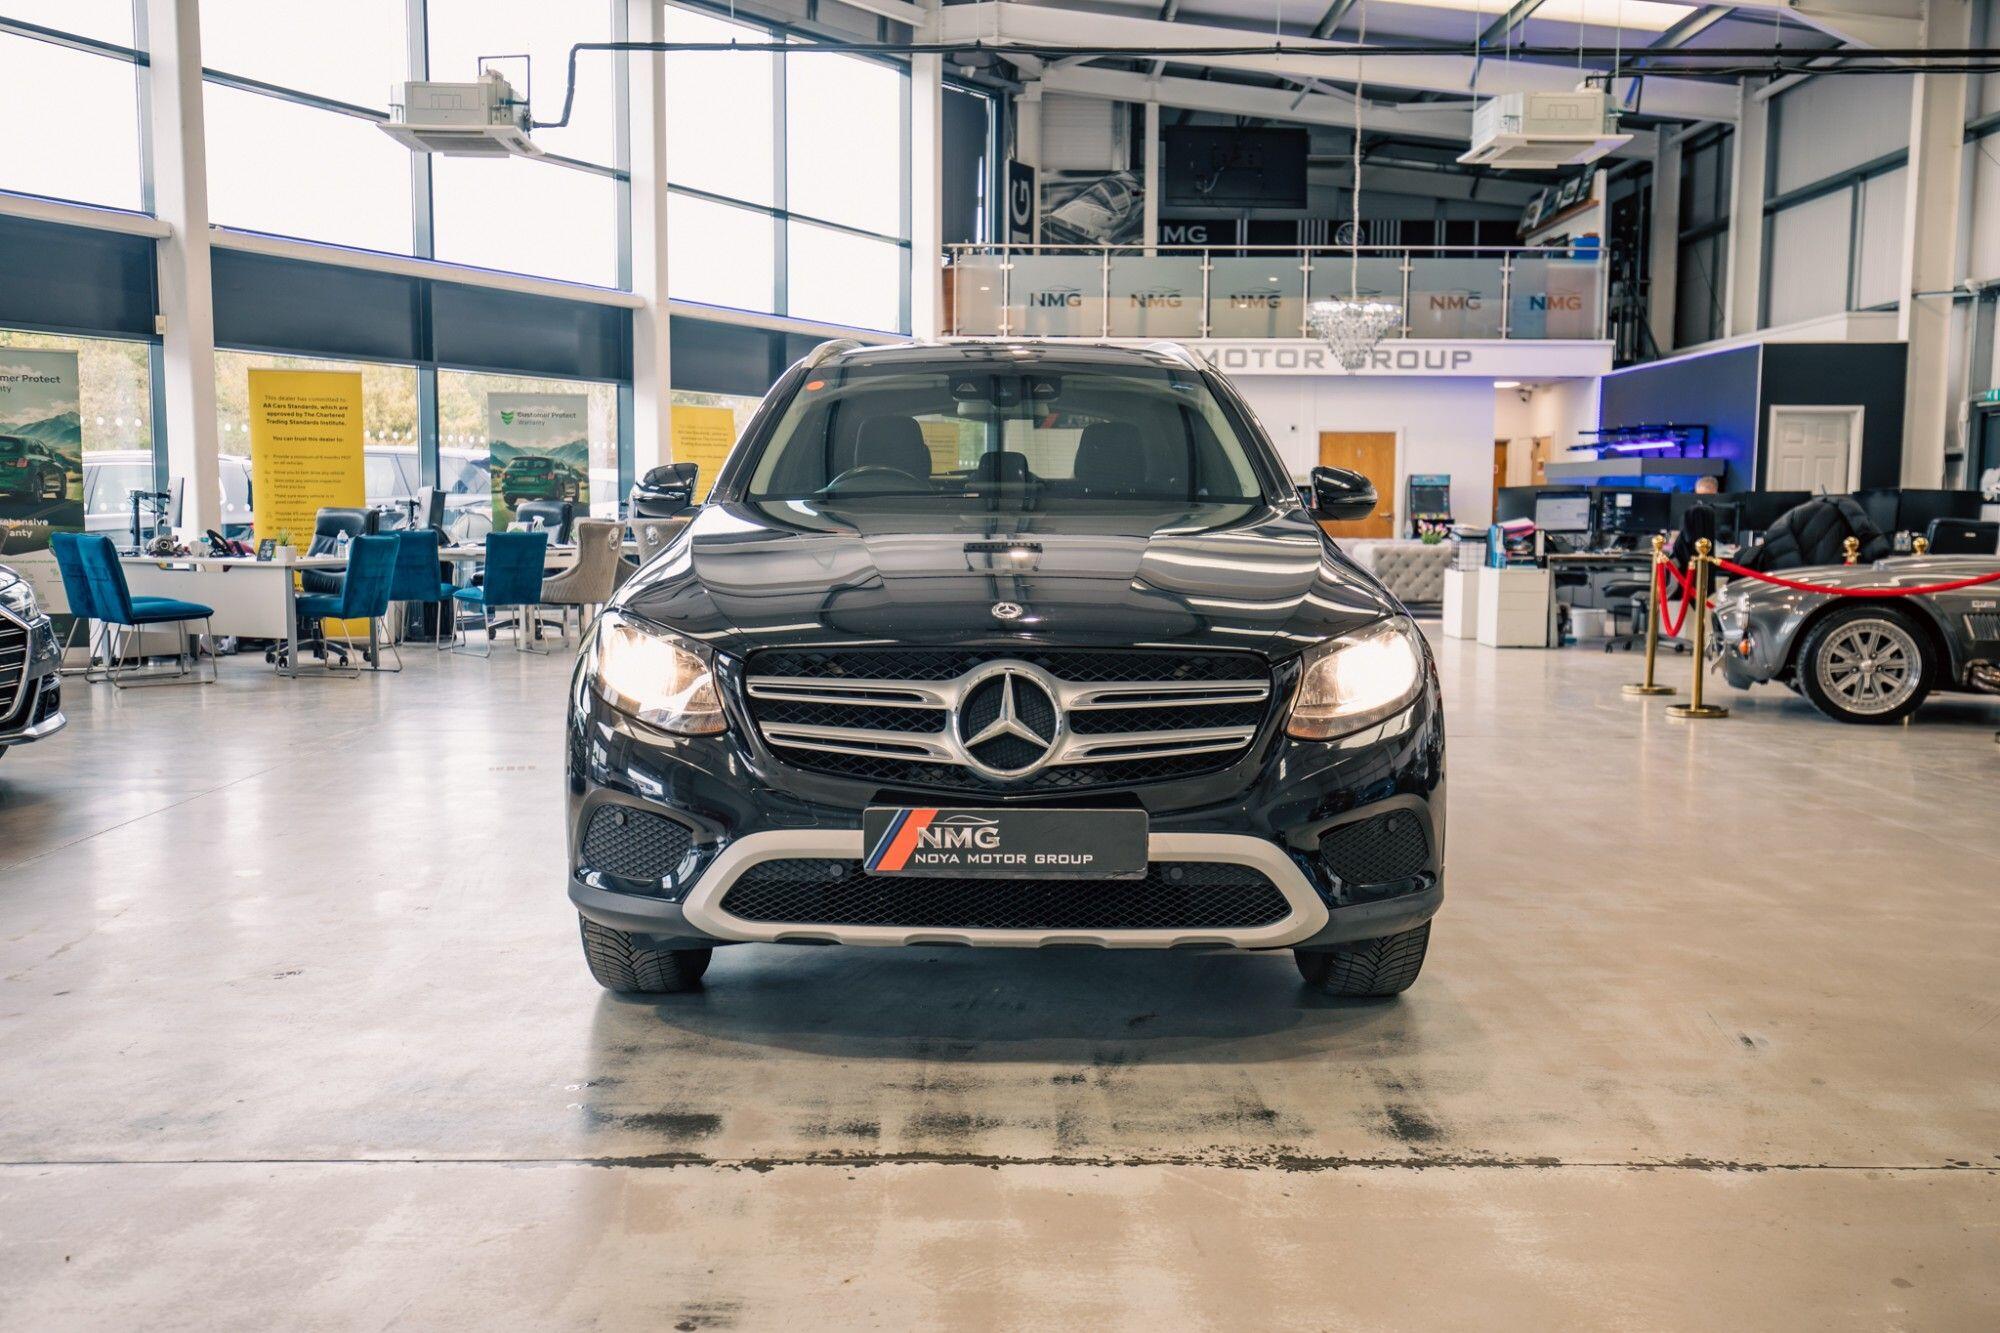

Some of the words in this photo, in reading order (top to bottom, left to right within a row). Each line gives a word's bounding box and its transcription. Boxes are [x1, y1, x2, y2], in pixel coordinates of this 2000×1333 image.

[1030, 292, 1083, 308] NMG
[1130, 293, 1183, 308] NMG
[1230, 294, 1282, 309] NMG
[1429, 295, 1482, 310] NMG
[1530, 295, 1583, 310] NMG
[1344, 349, 1473, 370] ROUP
[22, 374, 62, 384] Protect
[551, 412, 577, 420] Protect
[917, 826, 1000, 849] NMG
[914, 853, 960, 864] NOYA
[967, 854, 1027, 864] MOTOR
[1034, 854, 1094, 865] GROUP
